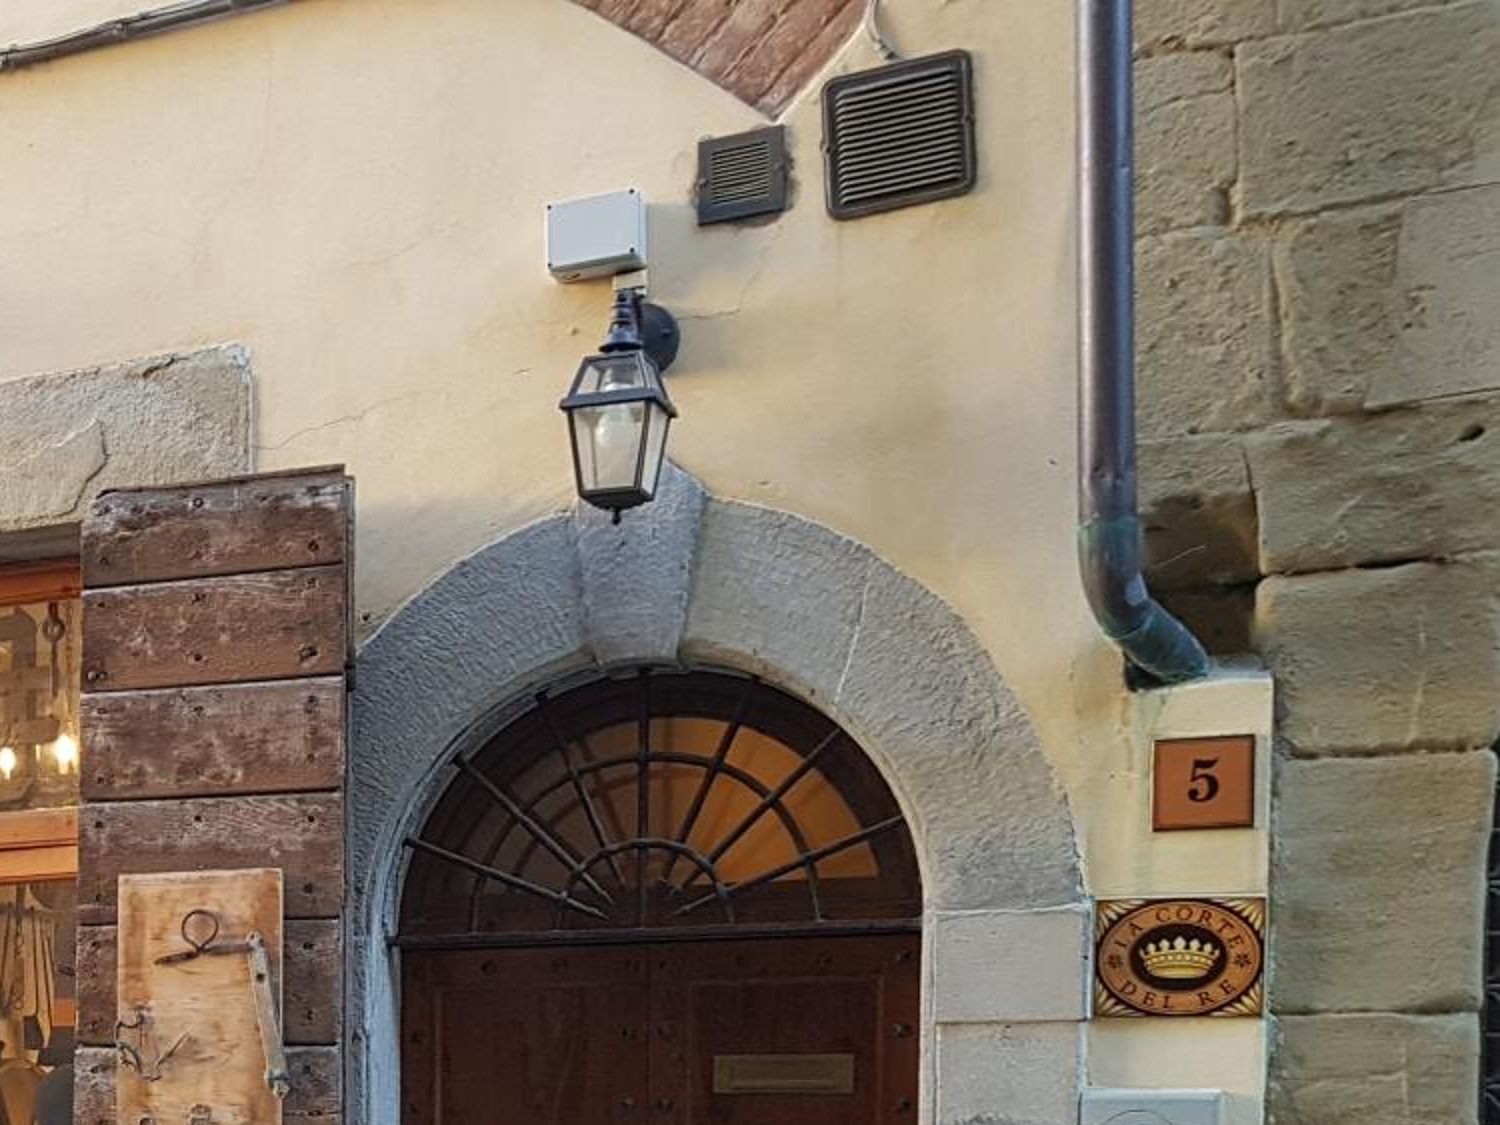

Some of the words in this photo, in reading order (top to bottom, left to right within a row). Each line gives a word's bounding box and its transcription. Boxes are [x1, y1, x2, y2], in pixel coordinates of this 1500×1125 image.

[1187, 756, 1220, 803] 5
[1155, 906, 1246, 949] CORTE
[1118, 980, 1176, 1009] DEL
[1197, 979, 1237, 1007] RE
